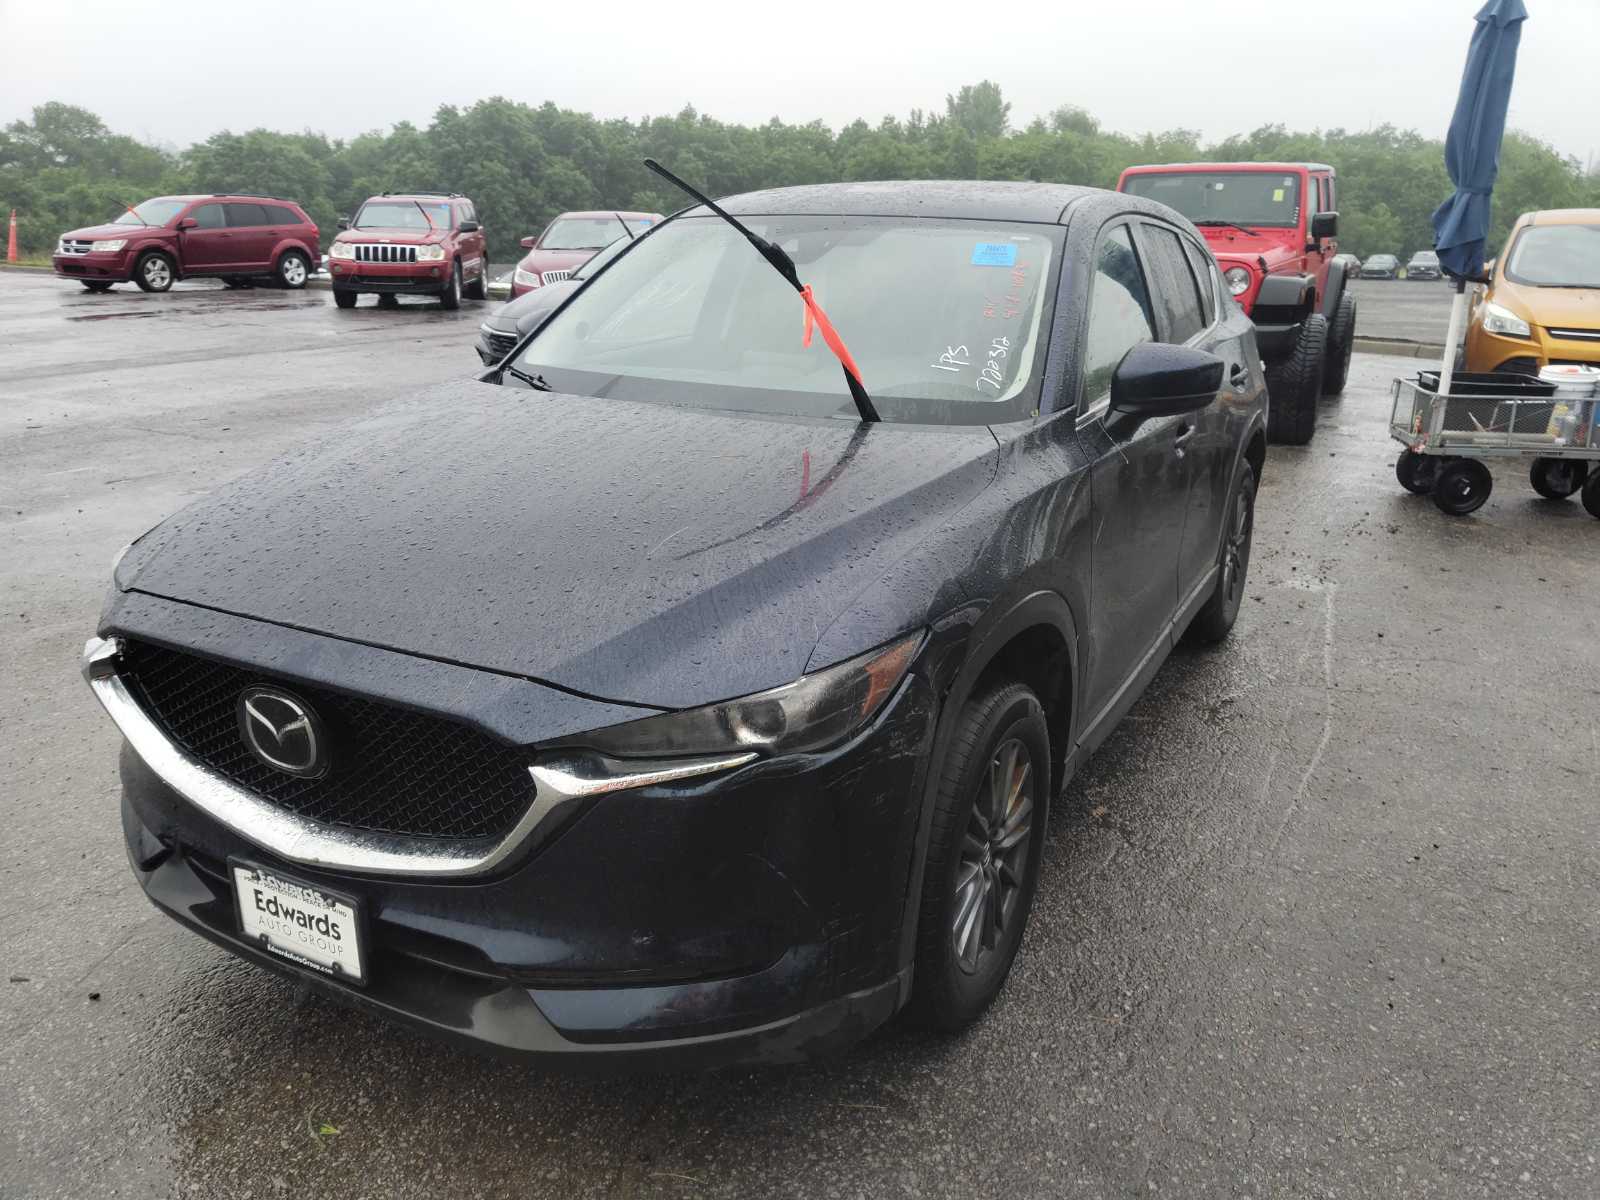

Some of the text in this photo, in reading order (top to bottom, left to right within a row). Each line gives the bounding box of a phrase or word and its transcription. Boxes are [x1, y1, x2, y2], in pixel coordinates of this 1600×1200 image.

[253, 888, 342, 941] Edwards
[258, 915, 344, 957] AUTO GROUP
